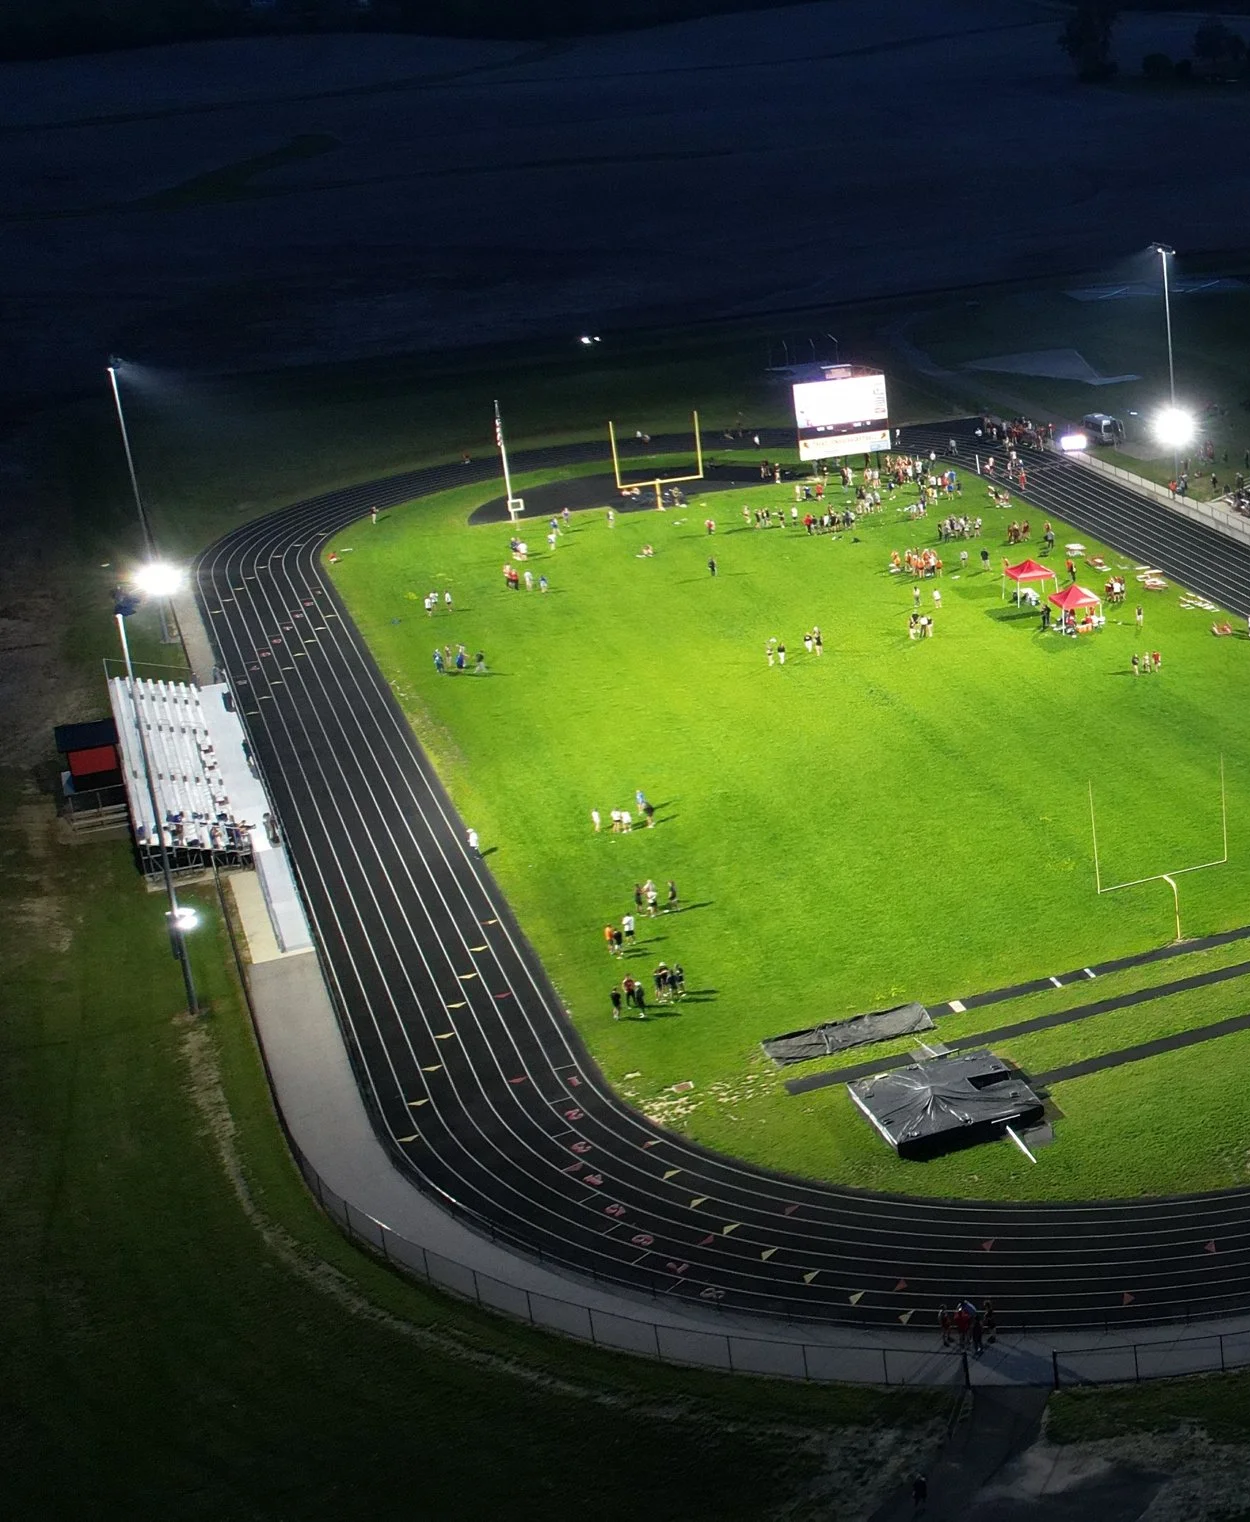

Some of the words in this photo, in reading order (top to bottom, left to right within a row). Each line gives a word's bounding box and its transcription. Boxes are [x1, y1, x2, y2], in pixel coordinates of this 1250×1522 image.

[567, 1076, 582, 1087] 1
[564, 1108, 584, 1120] 2
[570, 1141, 592, 1153] 3
[583, 1174, 604, 1187] 4
[603, 1203, 626, 1217] 5
[631, 1233, 654, 1247] 6
[699, 1287, 726, 1299] 8
